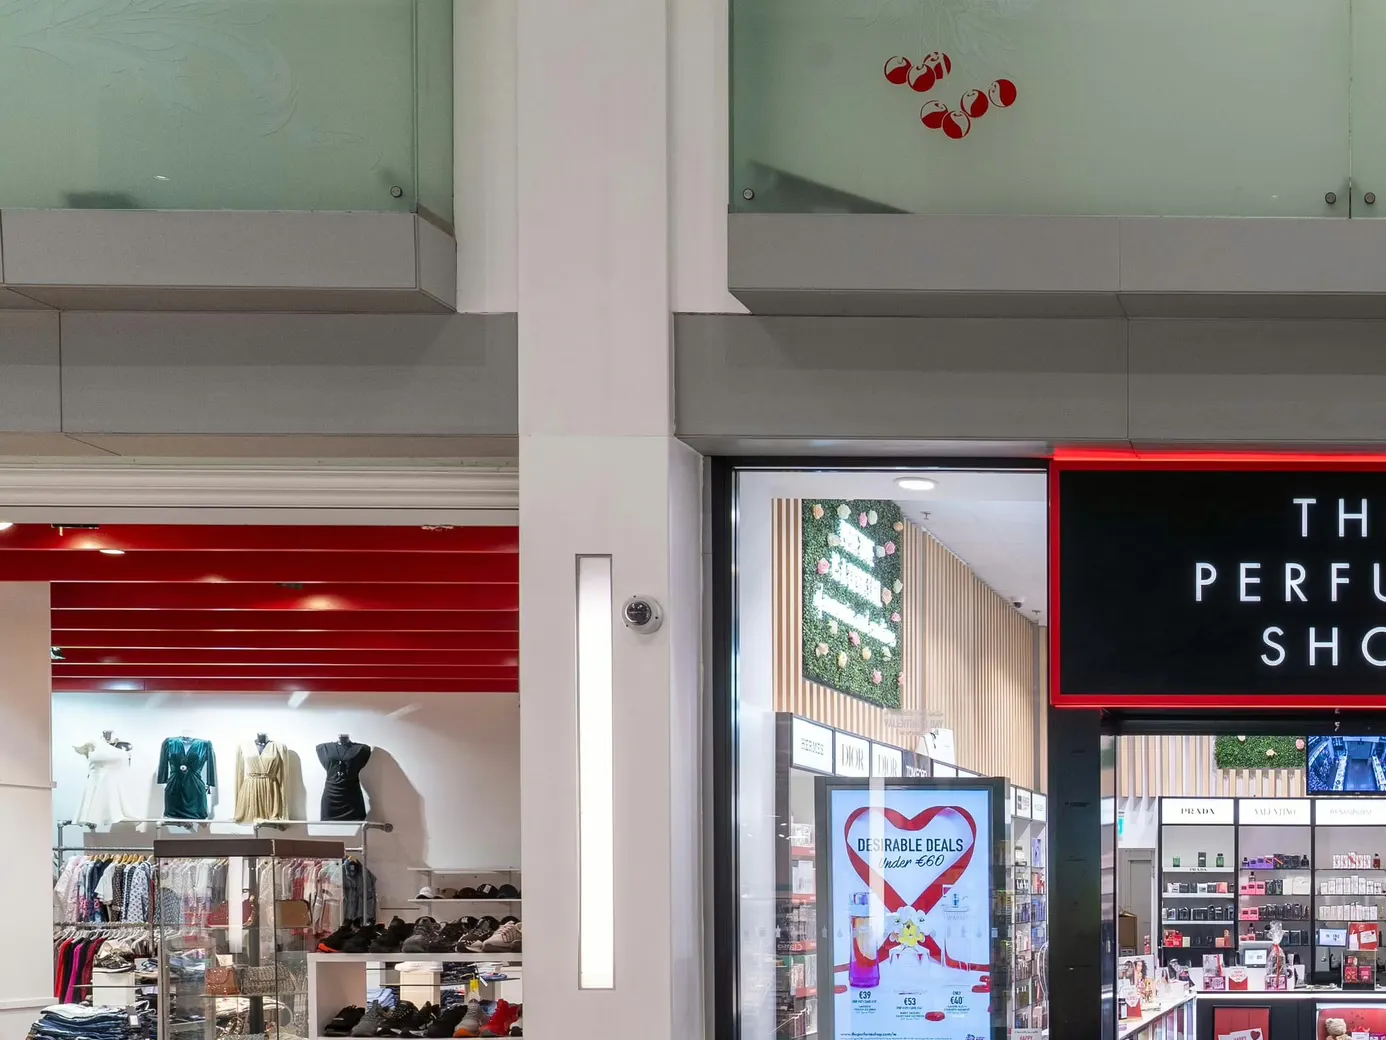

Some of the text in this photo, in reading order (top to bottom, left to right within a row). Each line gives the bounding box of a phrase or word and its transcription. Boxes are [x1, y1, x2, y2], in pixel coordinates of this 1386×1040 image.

[841, 743, 864, 771] DIOR
[877, 754, 898, 776] DIOR
[858, 838, 964, 852] DESIRABLE DEALS
[878, 854, 945, 869] Under €60
[858, 990, 872, 1000] €39
[903, 997, 917, 1006] €53
